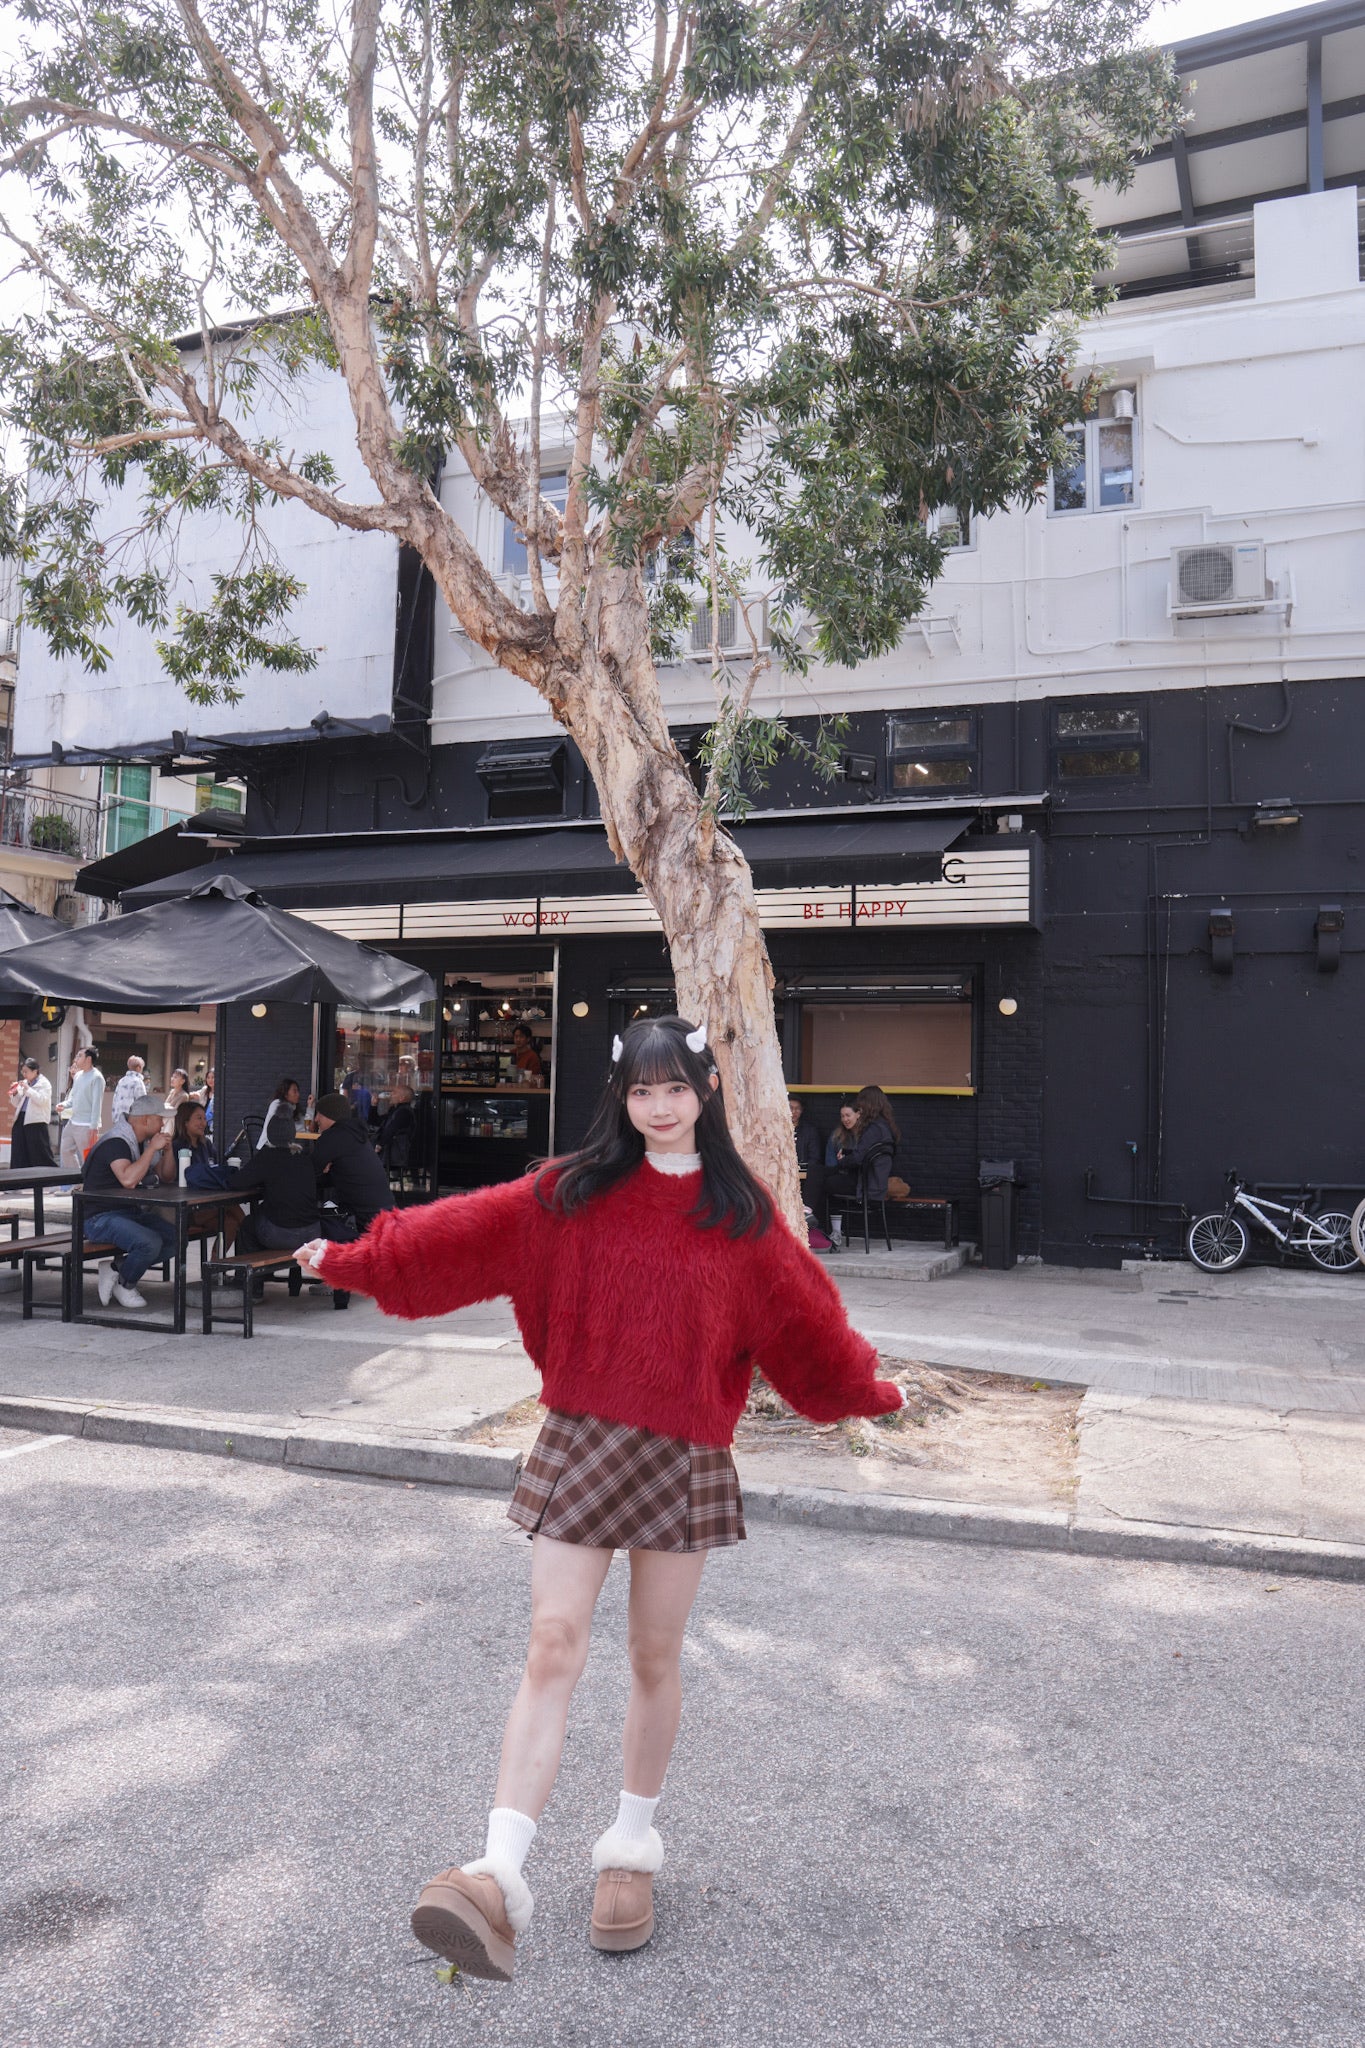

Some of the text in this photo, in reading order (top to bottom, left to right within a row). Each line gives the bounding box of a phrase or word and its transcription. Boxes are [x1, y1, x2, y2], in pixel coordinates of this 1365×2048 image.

[502, 901, 908, 928] WORRY BE HAPPY
